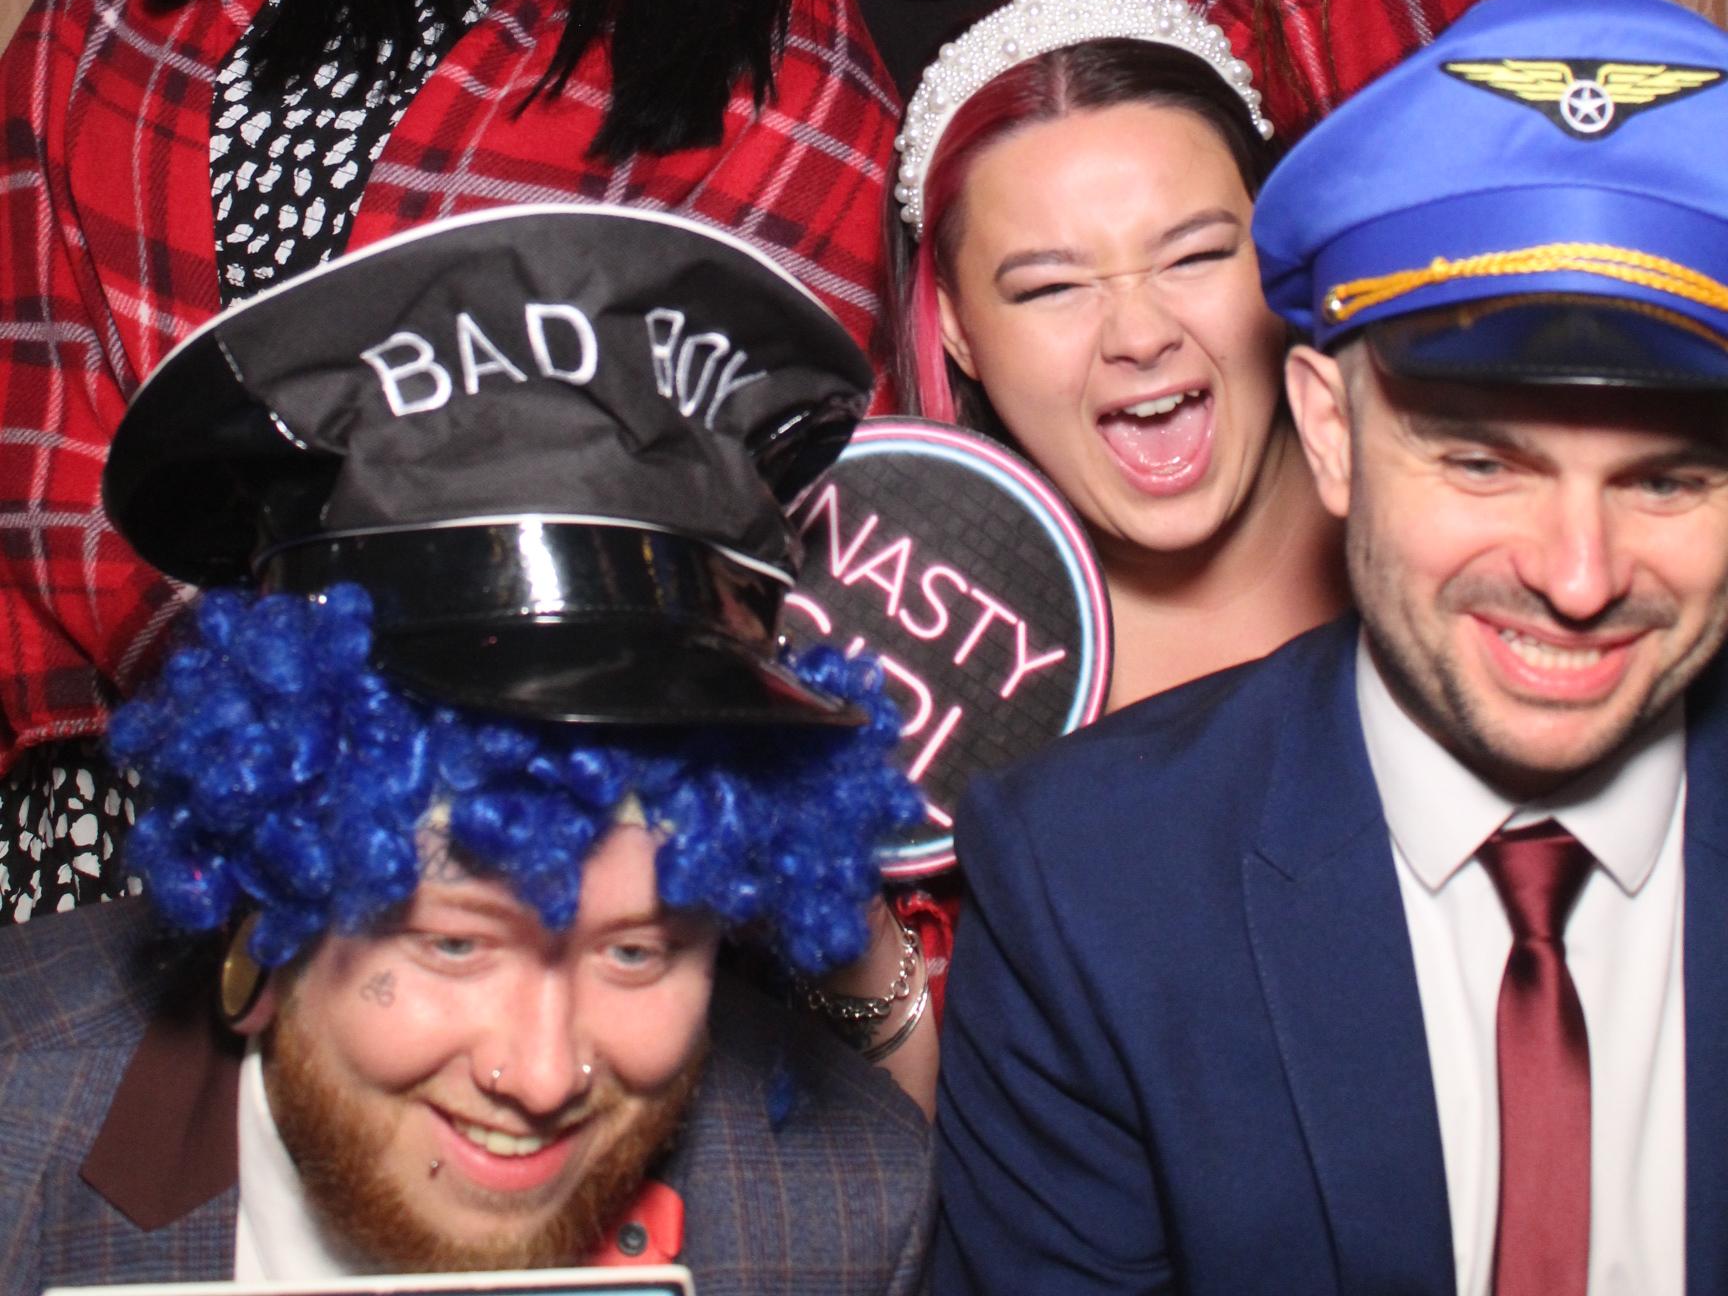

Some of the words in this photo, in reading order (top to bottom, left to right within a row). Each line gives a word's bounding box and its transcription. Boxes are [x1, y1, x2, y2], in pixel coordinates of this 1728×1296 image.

[359, 301, 600, 418] BAD
[644, 307, 768, 431] BOY
[798, 482, 1067, 700] NASTY
